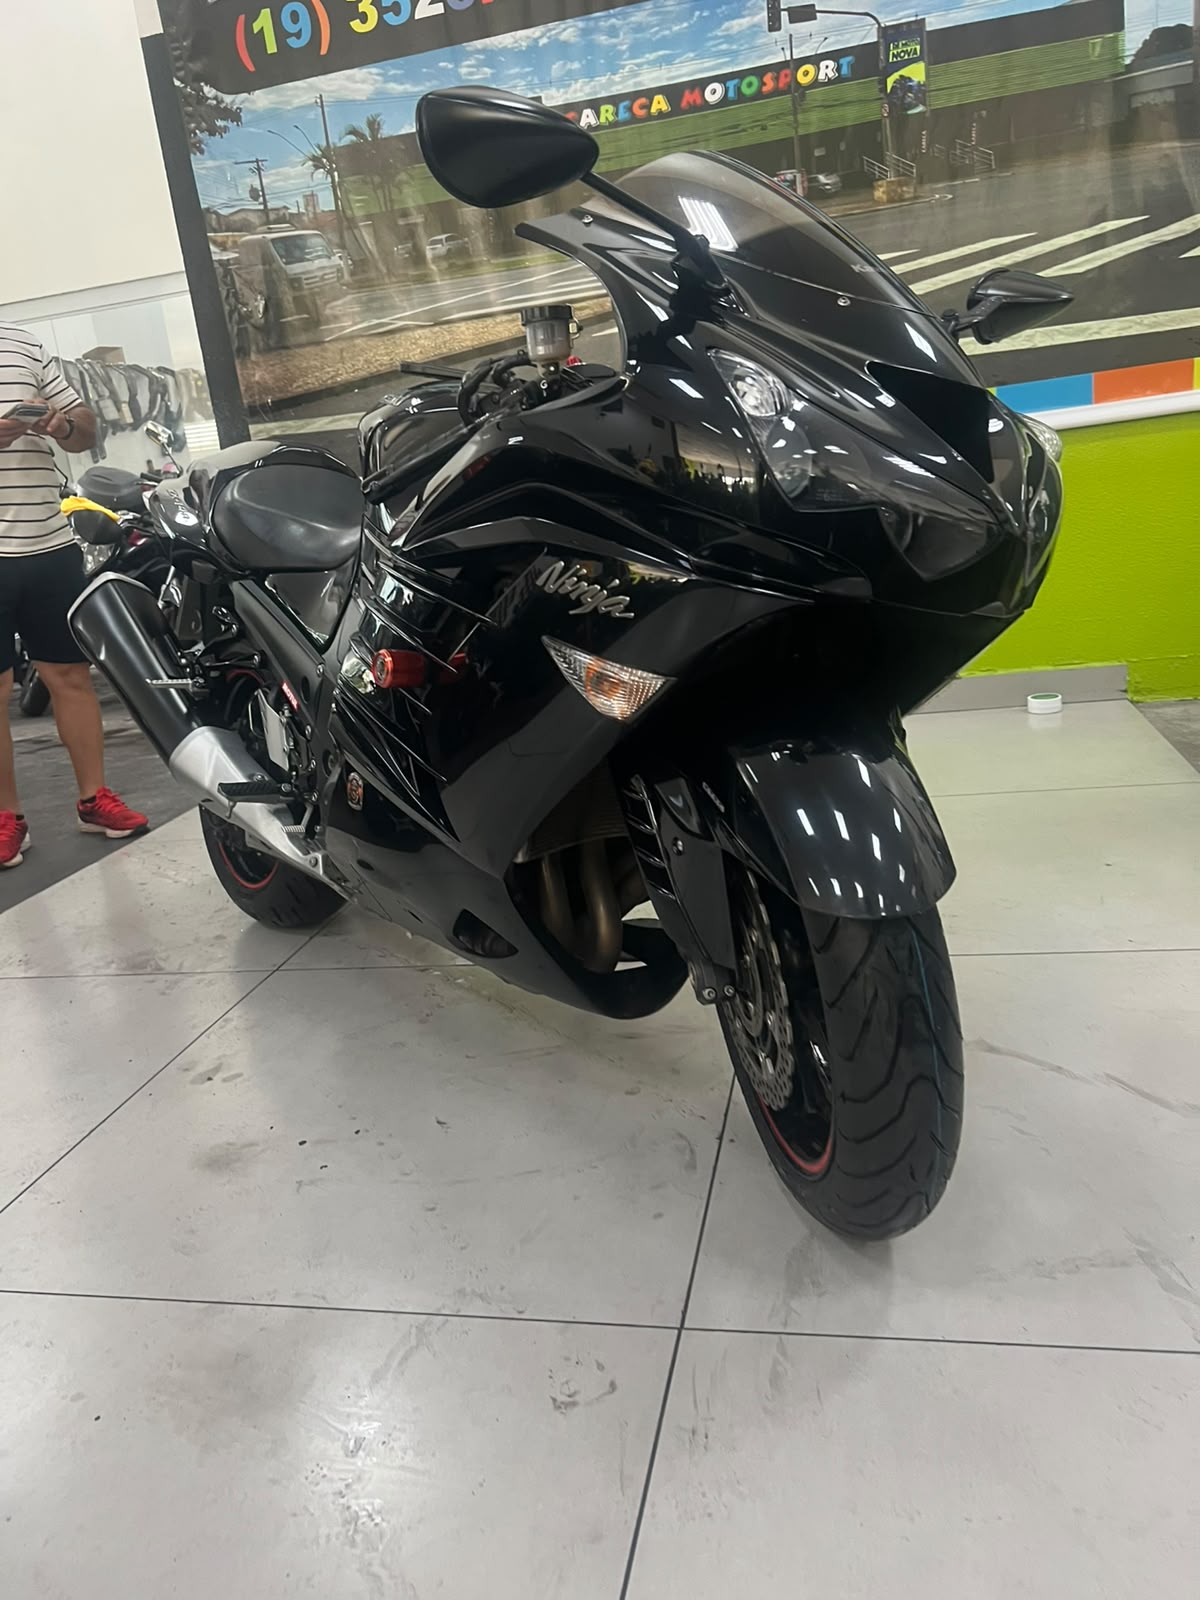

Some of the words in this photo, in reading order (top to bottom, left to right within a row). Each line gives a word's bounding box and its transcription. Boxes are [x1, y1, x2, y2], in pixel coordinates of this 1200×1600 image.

[235, 0, 331, 72] (19)
[891, 46, 919, 61] NOVA
[680, 55, 856, 111] MOTOSPORT
[536, 560, 635, 619] Ninja
